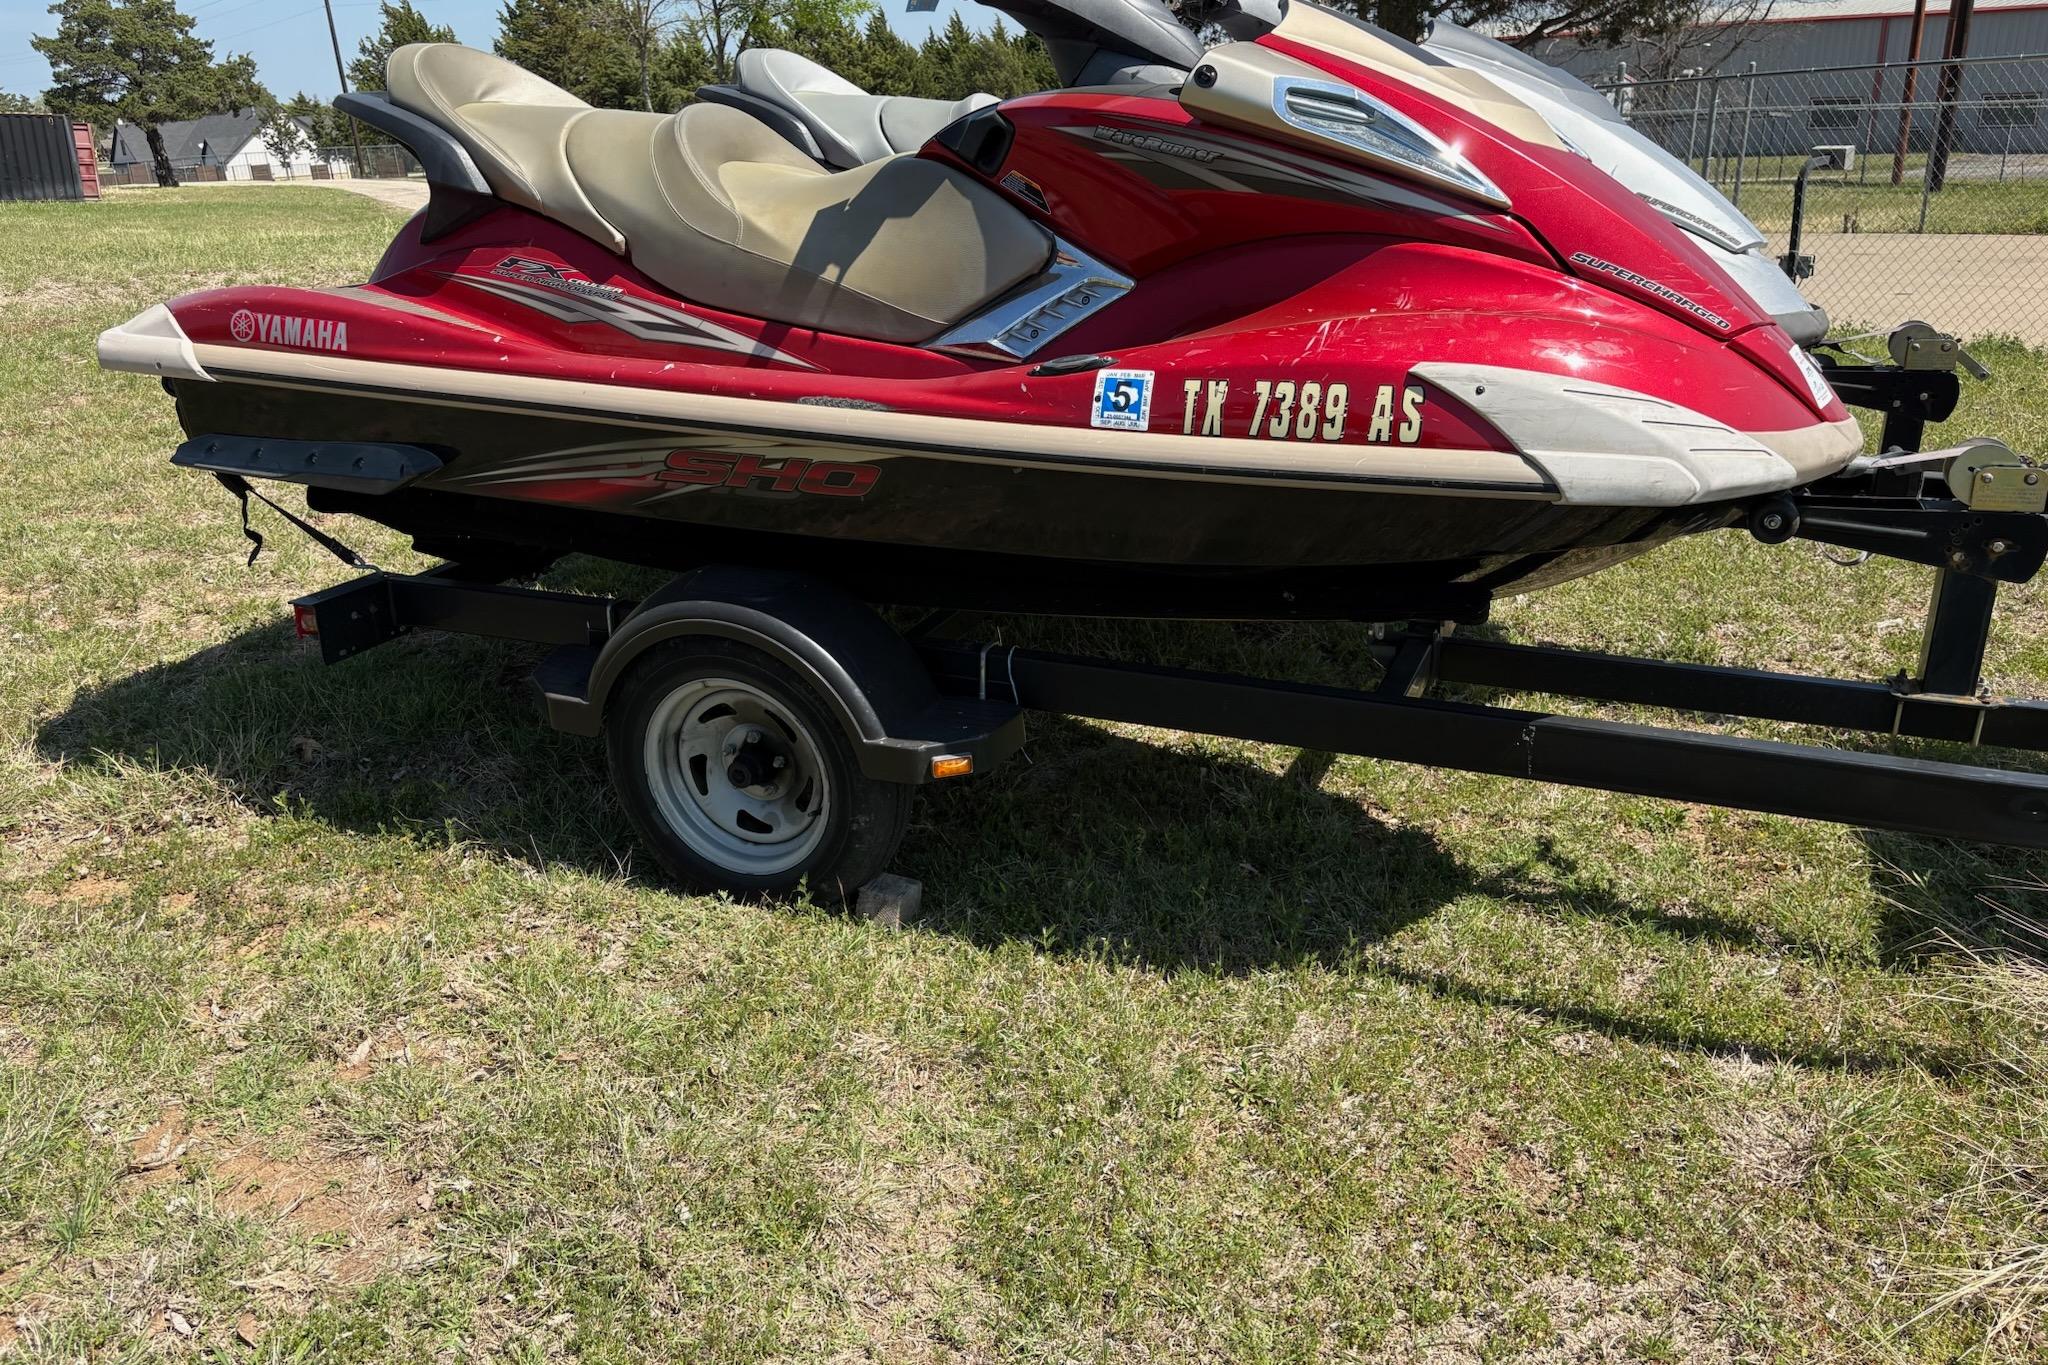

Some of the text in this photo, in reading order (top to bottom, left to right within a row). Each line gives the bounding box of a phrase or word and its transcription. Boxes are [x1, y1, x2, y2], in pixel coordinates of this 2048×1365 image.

[496, 255, 579, 281] FX
[1570, 252, 1731, 331] SUPERCHARGED
[257, 313, 348, 351] YAMAHA
[1112, 380, 1133, 412] 5
[1183, 379, 1425, 443] TX 7389 AS
[654, 450, 882, 497] SHO
